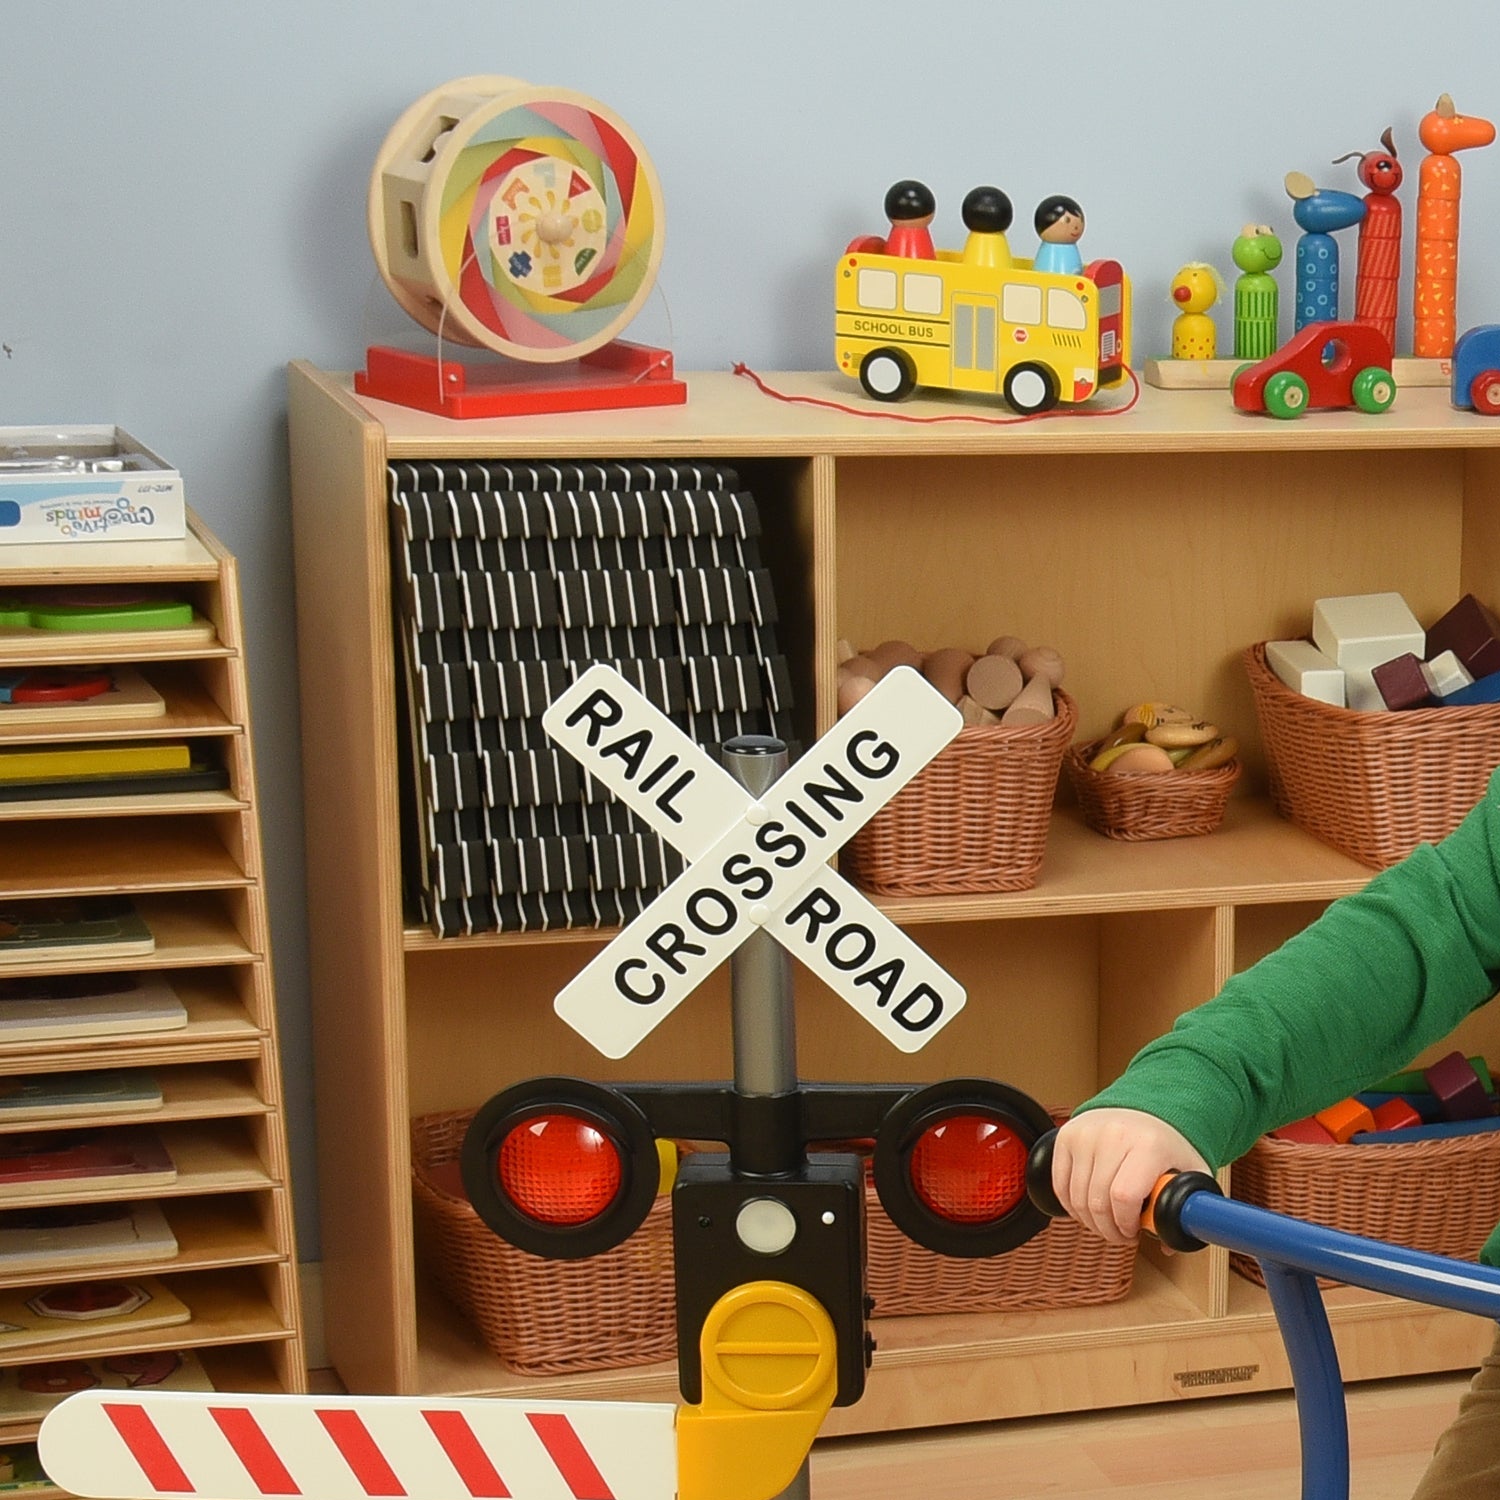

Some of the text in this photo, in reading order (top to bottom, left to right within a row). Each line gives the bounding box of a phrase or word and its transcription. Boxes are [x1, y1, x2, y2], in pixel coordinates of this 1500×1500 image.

[853, 319, 934, 338] SCHOOL BUS
[1440, 362, 1451, 376] 5
[46, 506, 102, 527] minds
[565, 688, 696, 824] RAIL
[614, 730, 900, 1005] CROSSING
[785, 887, 944, 1032] ROAD
